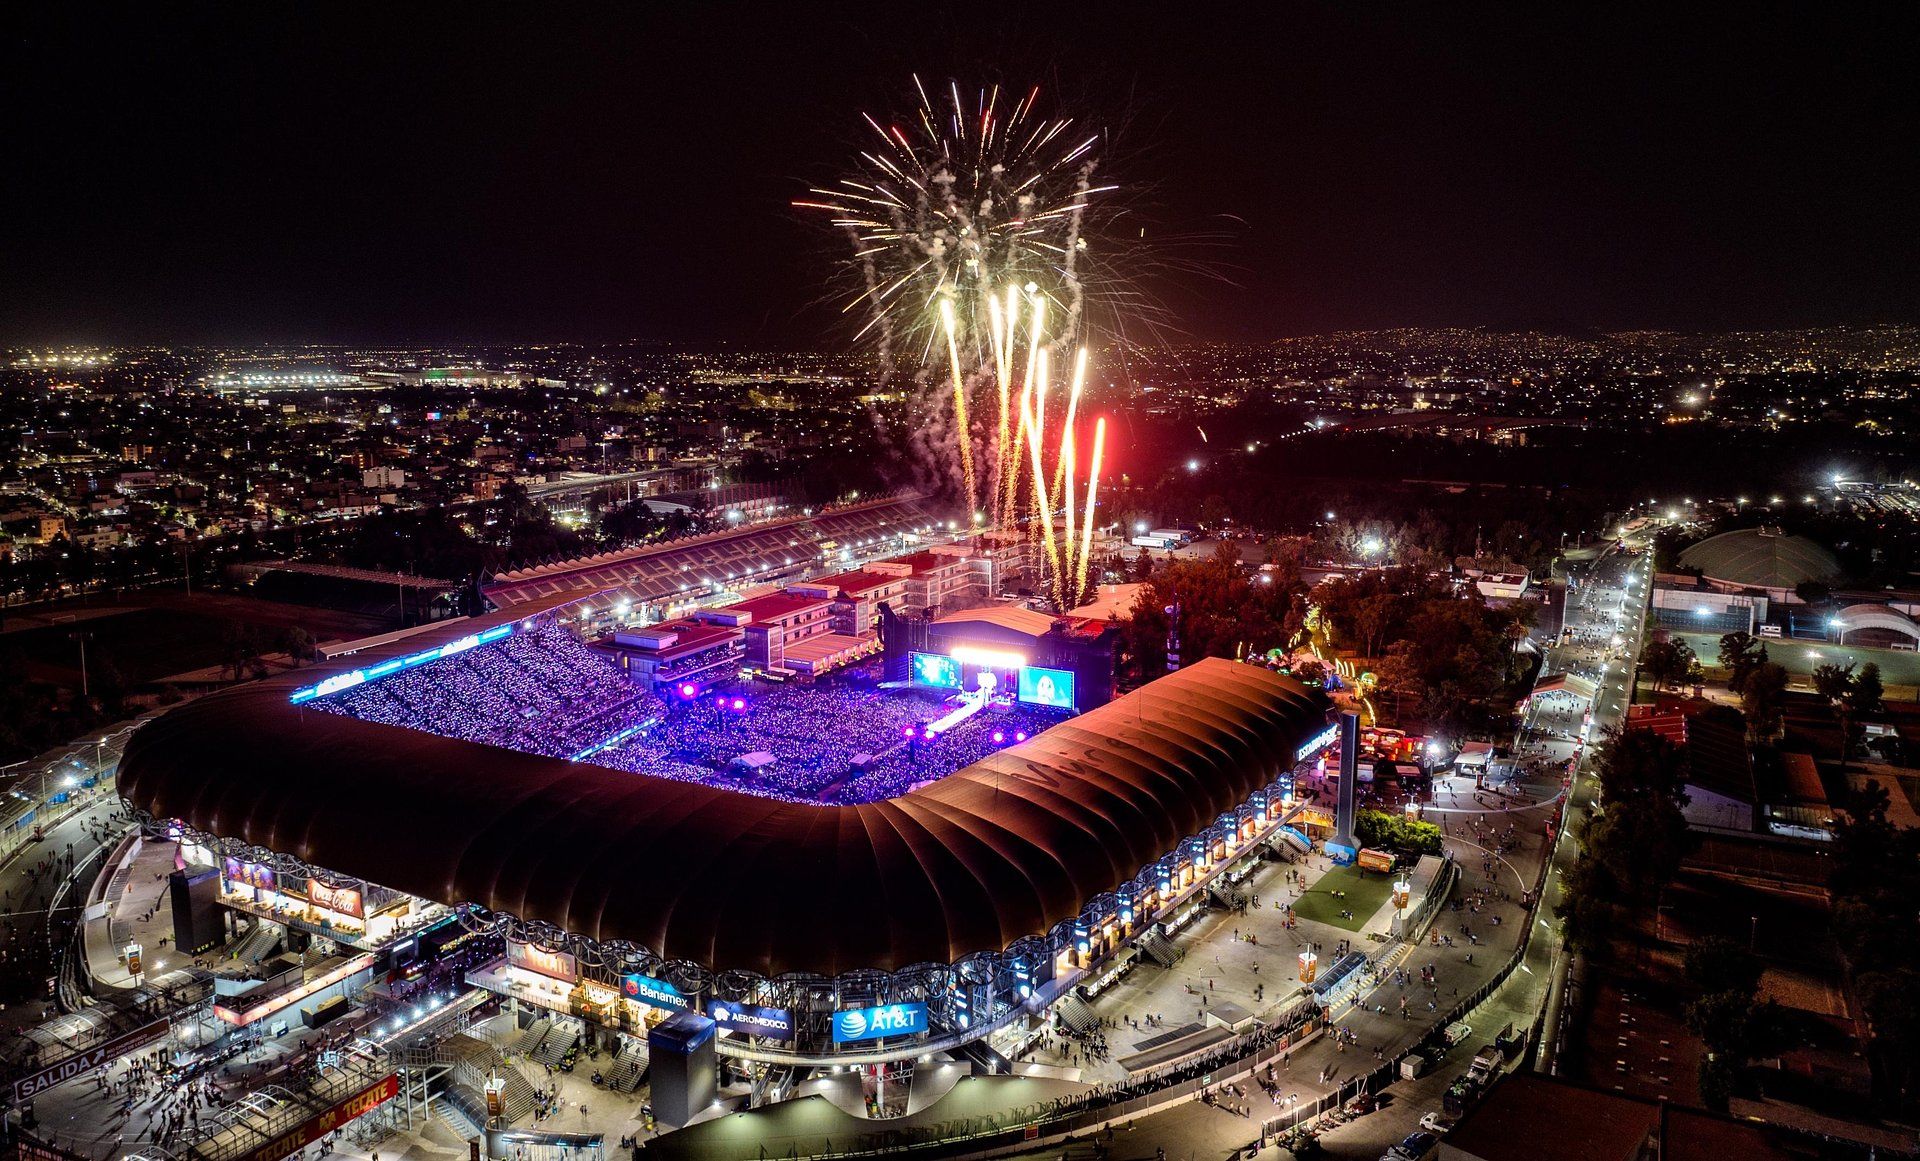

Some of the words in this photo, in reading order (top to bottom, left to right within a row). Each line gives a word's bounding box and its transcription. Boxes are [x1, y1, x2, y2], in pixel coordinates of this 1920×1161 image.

[639, 984, 688, 1009] Banamex
[870, 1005, 918, 1031] AT&T
[22, 1056, 91, 1096] SALIDA
[343, 1082, 389, 1118] TECATE
[255, 1129, 306, 1161] TECATE
